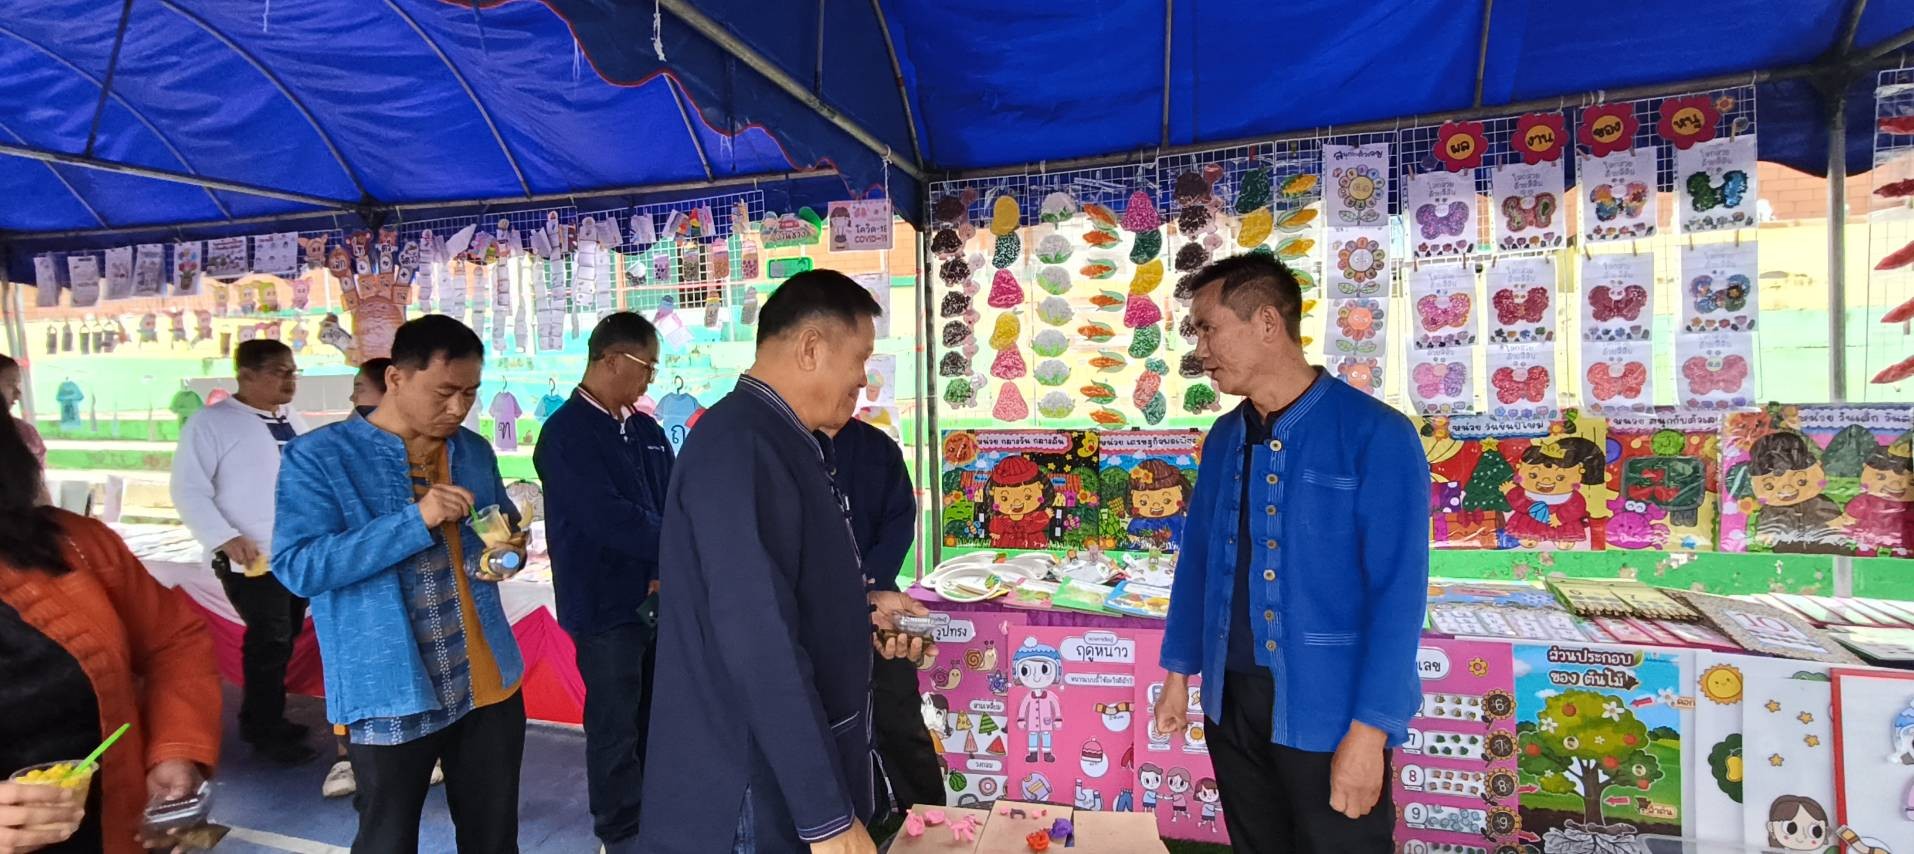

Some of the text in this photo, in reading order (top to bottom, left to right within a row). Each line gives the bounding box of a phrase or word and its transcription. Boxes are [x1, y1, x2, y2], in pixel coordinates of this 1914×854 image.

[1450, 114, 1702, 154] ผล งาน ของ หนู
[1649, 414, 1718, 428] สนุกกับตัวเล
[1076, 645, 1128, 662] ฤดูหนาว
[1549, 646, 1632, 665] ส่วนประกอบ
[1551, 669, 1624, 687] ของ ต้นไม้
[1495, 698, 1505, 710] 6
[1408, 733, 1416, 745] 7
[1409, 769, 1417, 782] 8
[1499, 780, 1507, 791] 8
[1411, 807, 1421, 820] 9
[1499, 817, 1508, 829] 9
